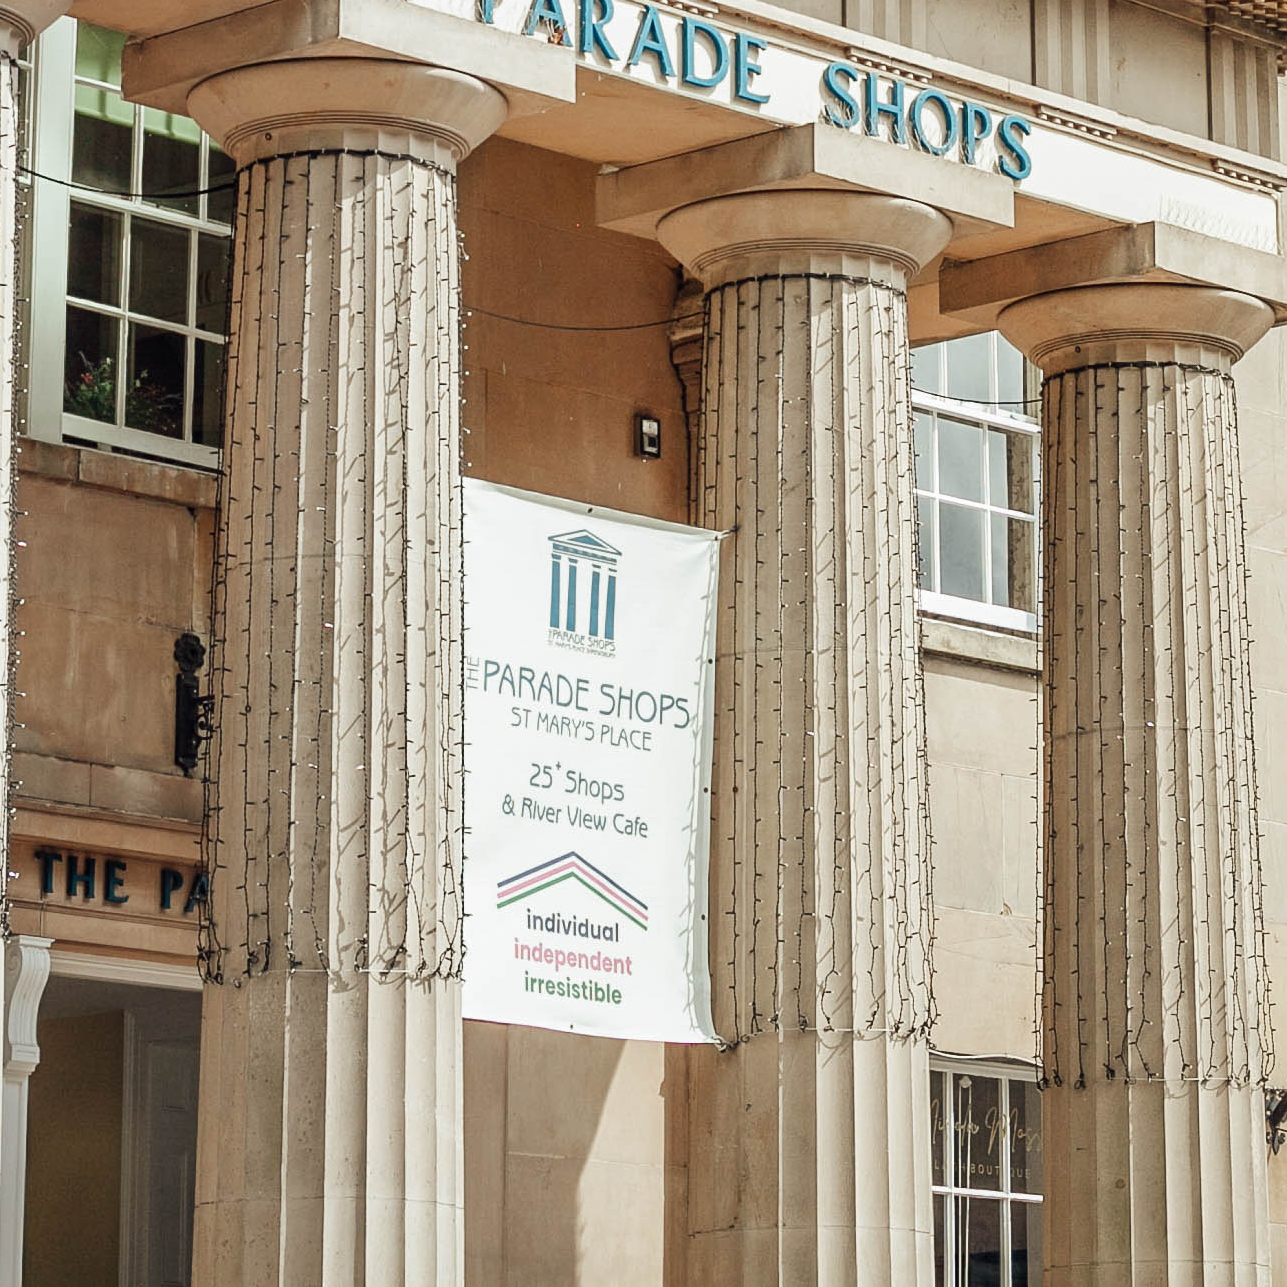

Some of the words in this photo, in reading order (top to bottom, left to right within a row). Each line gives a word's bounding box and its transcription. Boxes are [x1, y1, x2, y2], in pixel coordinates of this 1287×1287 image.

[820, 61, 1033, 182] SHOPS
[466, 656, 480, 690] THE
[483, 659, 590, 712] PARADE
[599, 683, 690, 729] SHOPS
[511, 706, 532, 728] ST
[537, 711, 595, 742] MARY'S
[601, 724, 652, 752] PLACE
[565, 770, 625, 805] Shops
[502, 793, 516, 817] &
[613, 813, 649, 839] Cafe
[35, 849, 130, 904] THE
[526, 907, 619, 943] individual
[514, 936, 633, 976] independent
[524, 970, 623, 1005] irresistible
